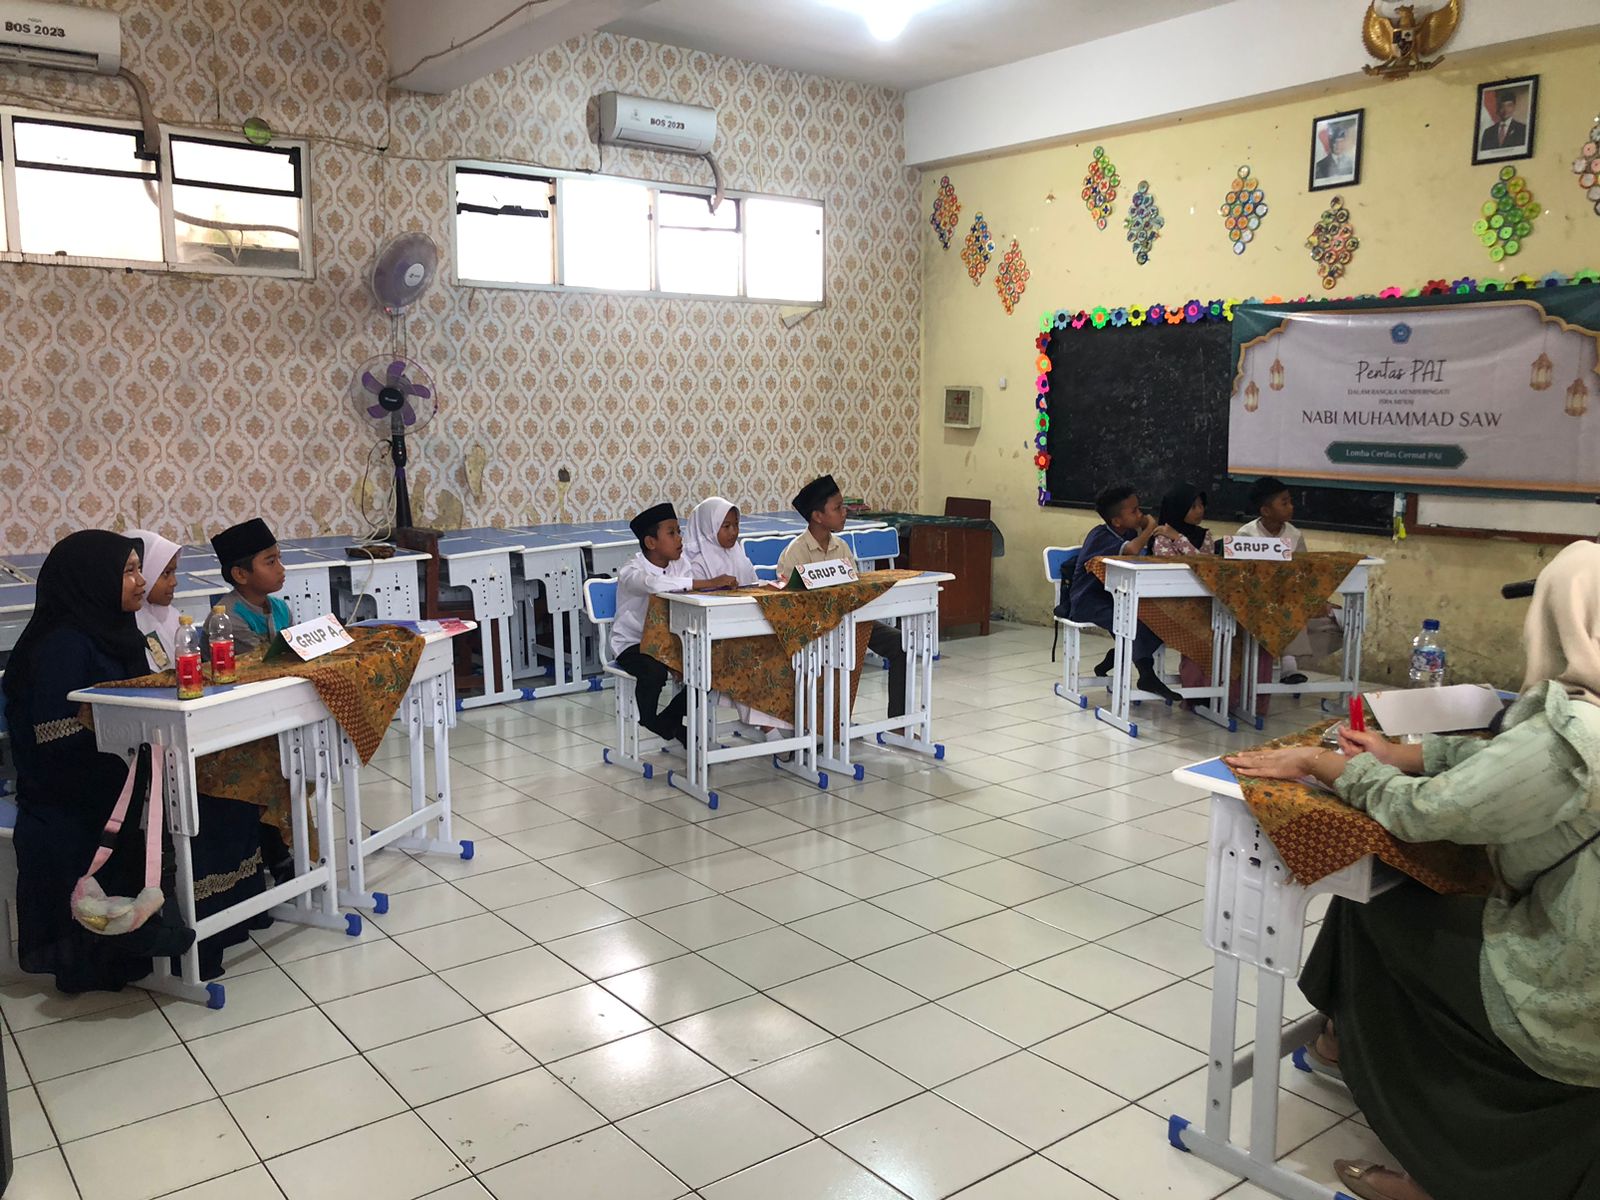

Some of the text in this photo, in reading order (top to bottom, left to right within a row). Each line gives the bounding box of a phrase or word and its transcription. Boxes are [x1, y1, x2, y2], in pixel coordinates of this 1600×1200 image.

[5, 21, 65, 38] BOS 2023
[650, 117, 666, 127] BOS
[667, 120, 685, 130] 2023
[1355, 356, 1447, 383] Pentas PAI
[1302, 410, 1502, 428] NABI MUHAMMAD SAW
[1234, 543, 1282, 552] GRUP C
[808, 565, 847, 580] GRUP B
[296, 625, 339, 648] GRUP A
